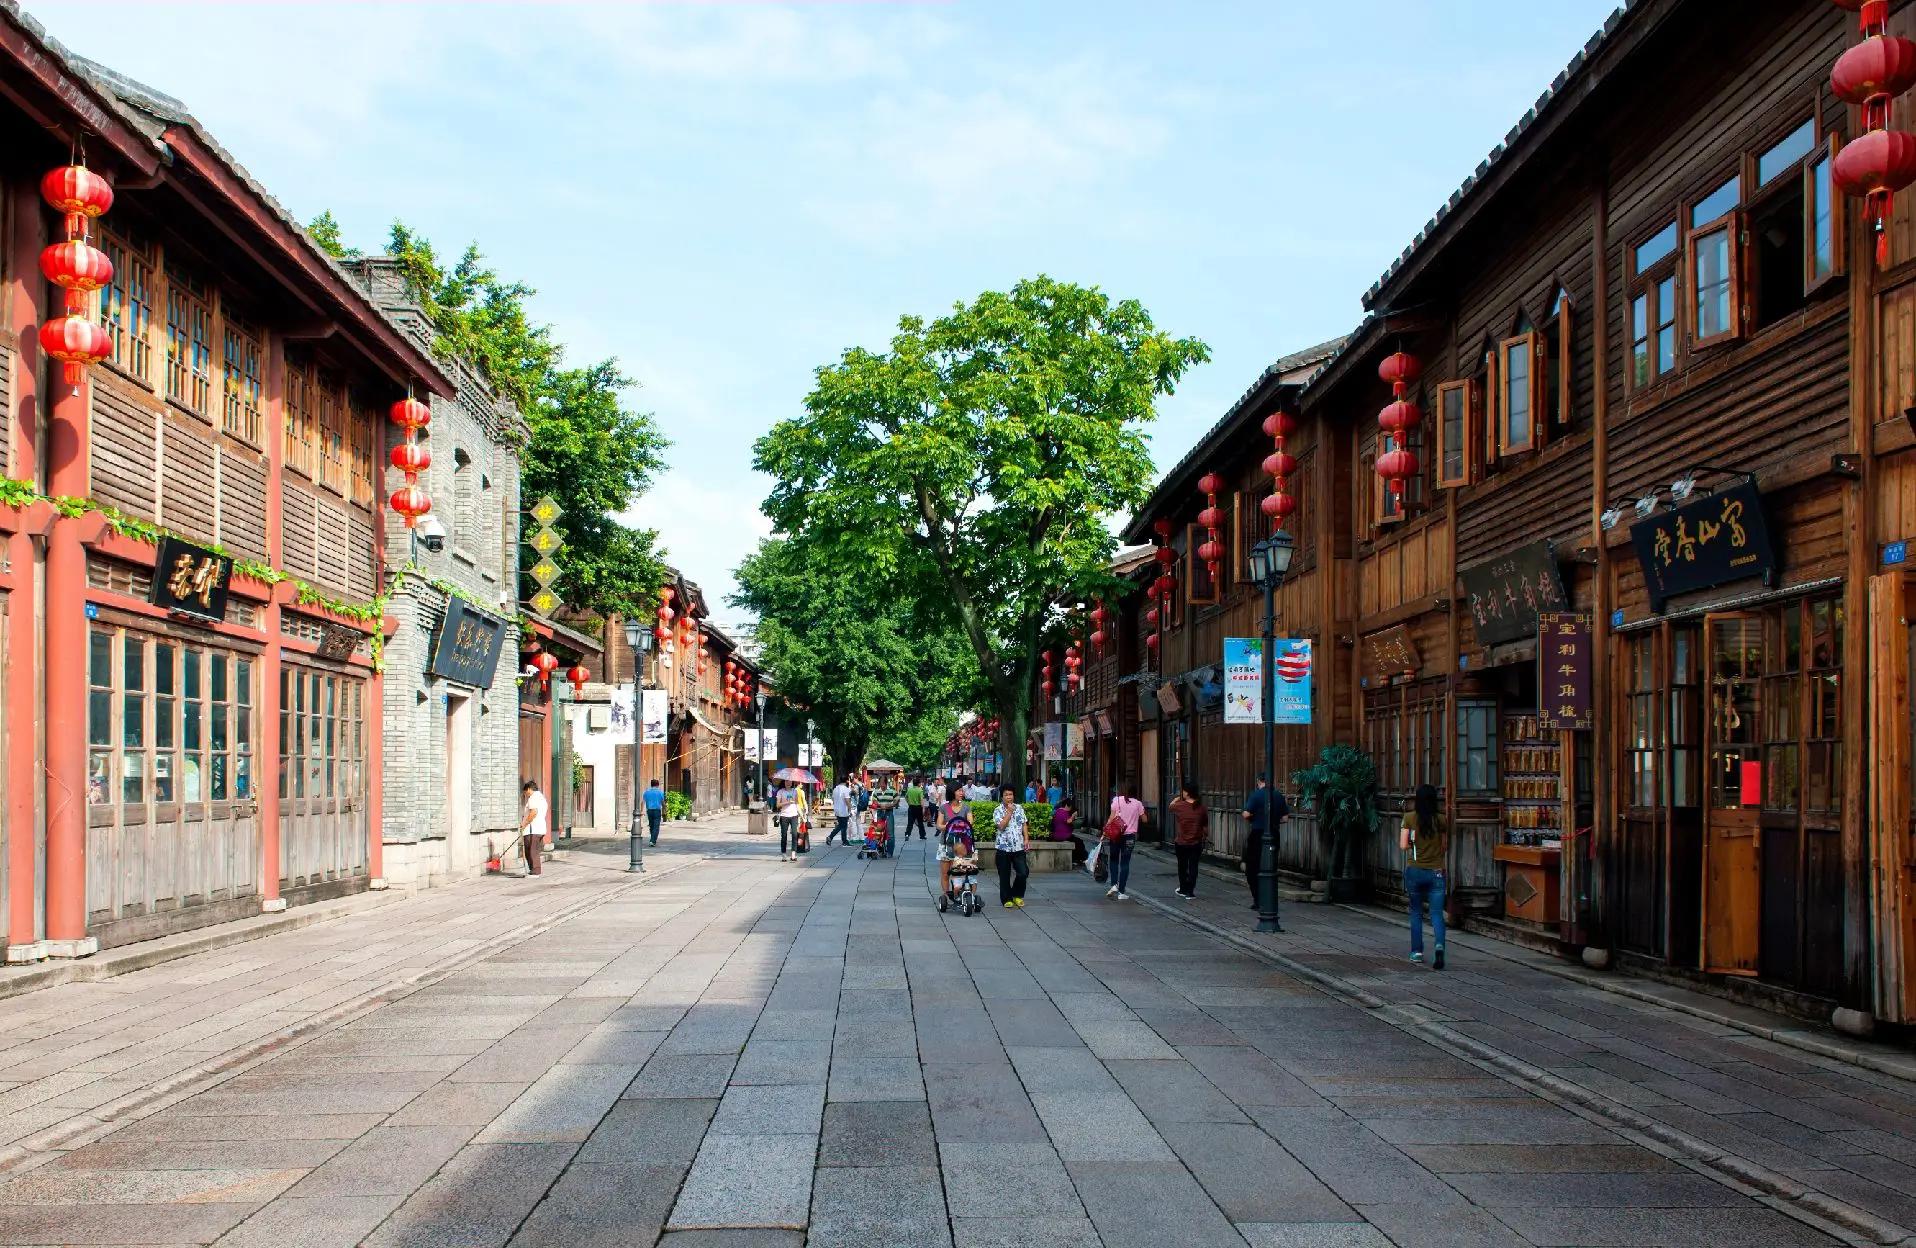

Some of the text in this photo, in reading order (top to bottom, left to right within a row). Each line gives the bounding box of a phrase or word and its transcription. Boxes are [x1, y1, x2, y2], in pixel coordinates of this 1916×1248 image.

[1557, 623, 1577, 717] 宝利牛角梳
